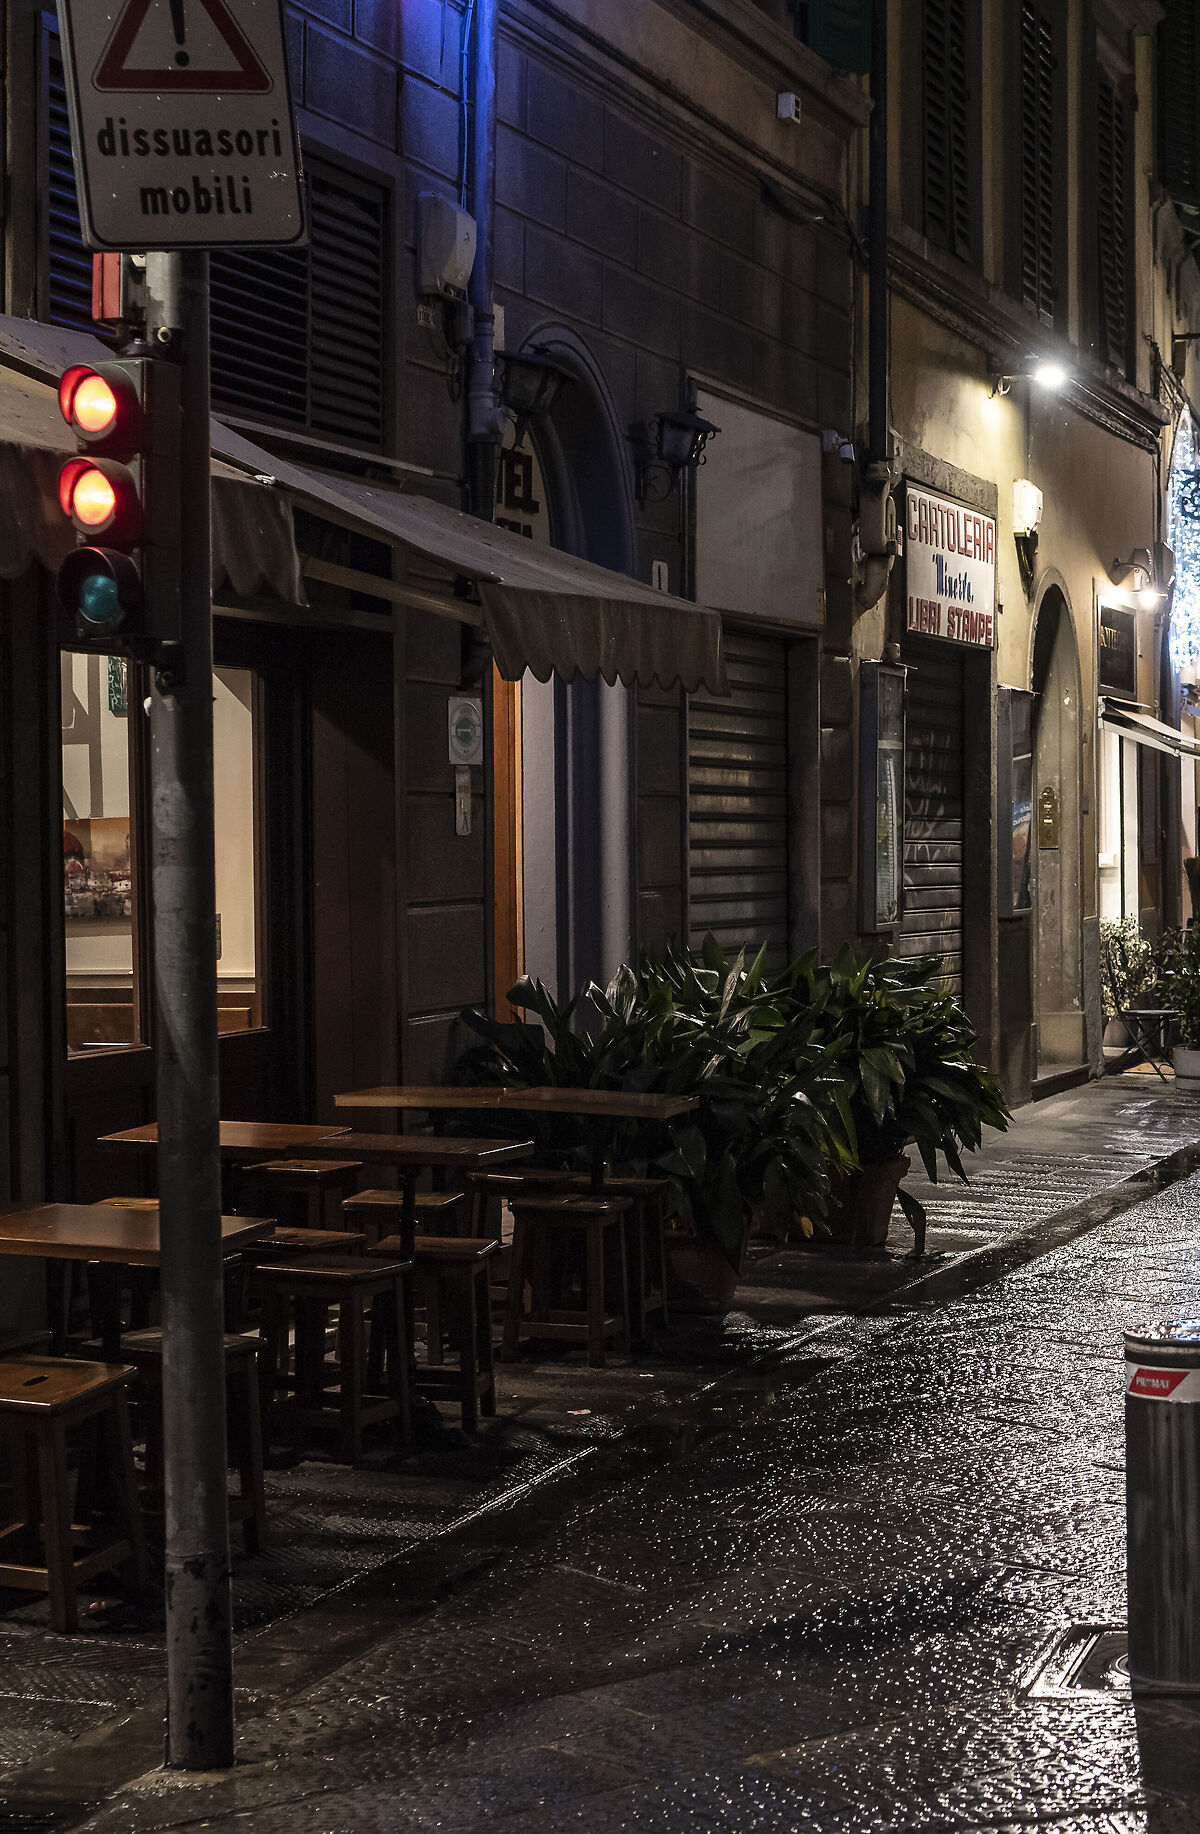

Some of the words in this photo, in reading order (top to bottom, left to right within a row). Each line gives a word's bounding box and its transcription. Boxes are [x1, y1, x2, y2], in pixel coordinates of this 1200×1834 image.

[97, 117, 282, 157] dissuasori
[140, 175, 253, 214] mobili
[907, 493, 994, 565] CARTOLERIA
[908, 596, 942, 635] LIBRI
[947, 606, 993, 645] STAMPE
